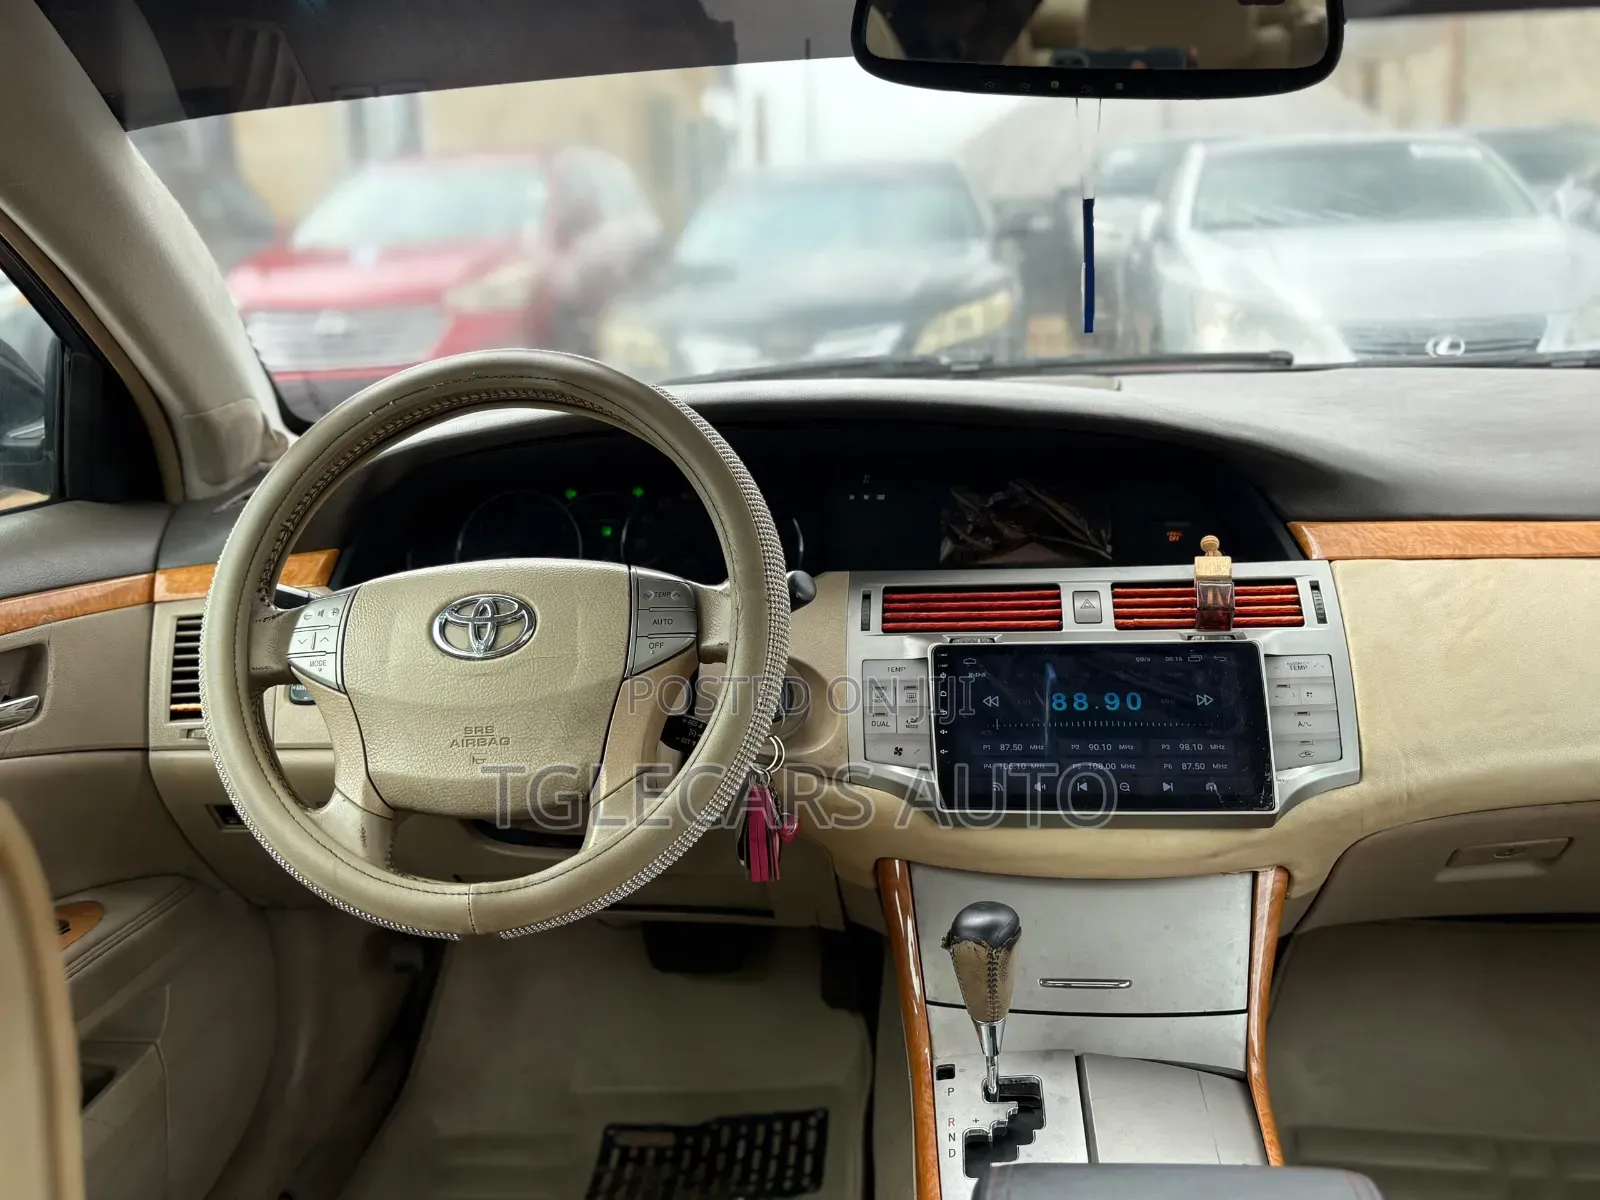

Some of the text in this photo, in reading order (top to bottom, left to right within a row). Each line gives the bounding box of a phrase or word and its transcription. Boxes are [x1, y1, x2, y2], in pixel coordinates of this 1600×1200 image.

[1052, 692, 1142, 711] 88.90
[687, 719, 699, 727] RES
[871, 720, 890, 728] DUAL
[464, 726, 495, 735] SRS
[450, 737, 511, 748] AIRBAG
[680, 737, 692, 745] SET
[947, 1087, 955, 1096] P
[948, 1118, 955, 1127] R
[948, 1132, 956, 1142] N
[948, 1148, 956, 1158] D
